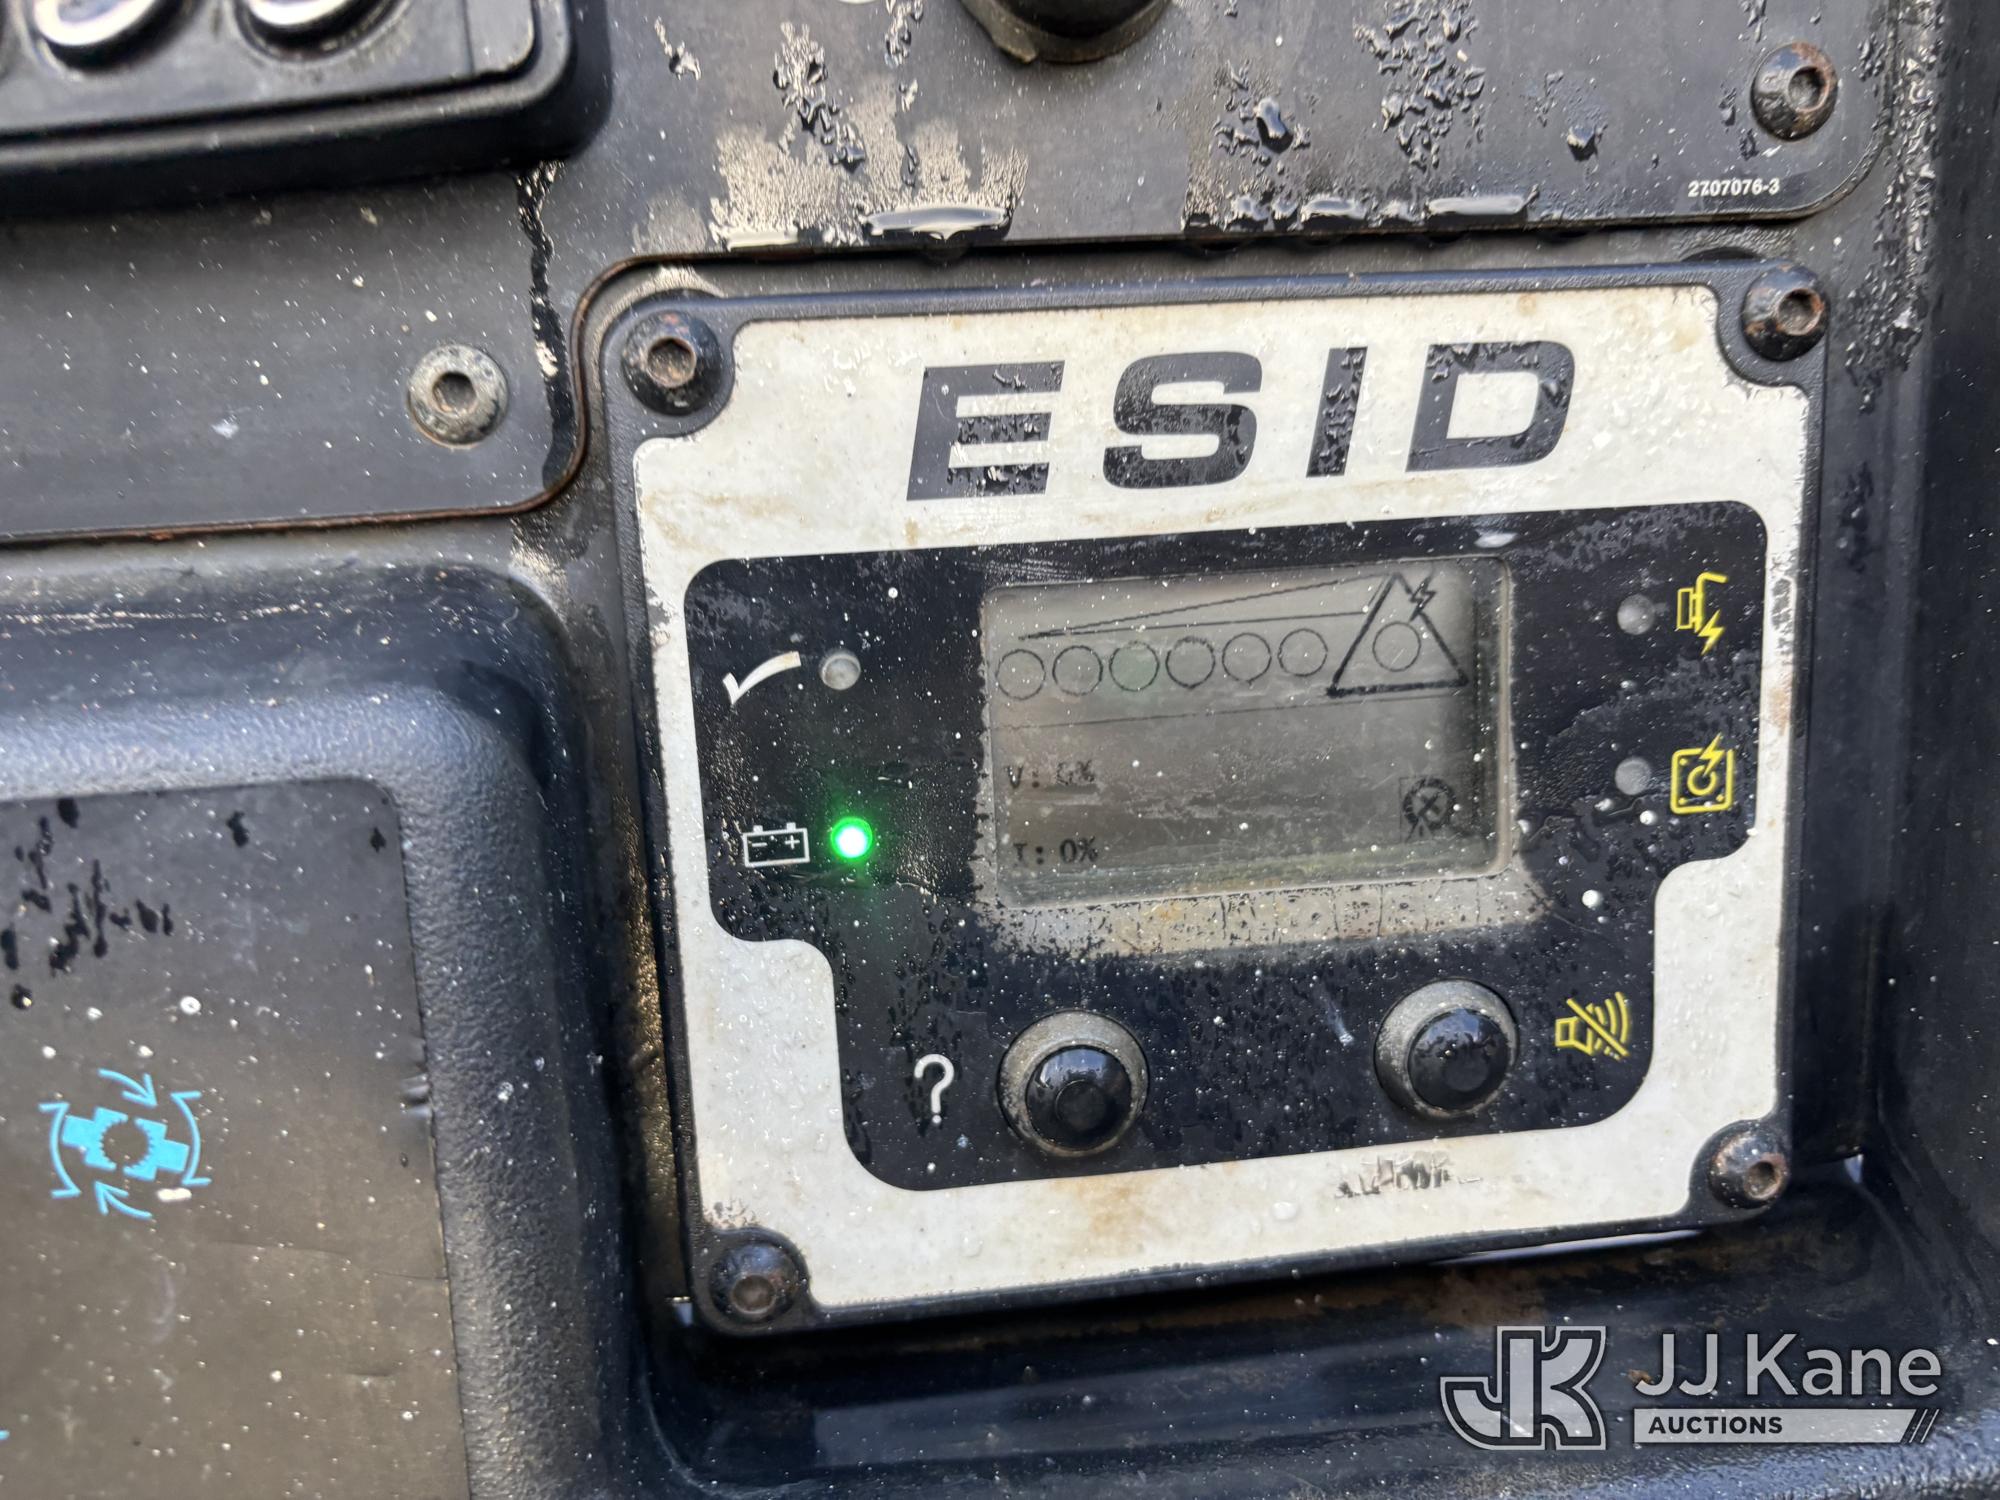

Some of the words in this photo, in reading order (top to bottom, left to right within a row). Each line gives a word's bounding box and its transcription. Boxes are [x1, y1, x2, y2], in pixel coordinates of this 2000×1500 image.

[1687, 178, 1780, 198] 2707076-3
[906, 341, 1577, 502] ESID
[1060, 836, 1099, 863] 0%
[914, 1053, 955, 1124] ?
